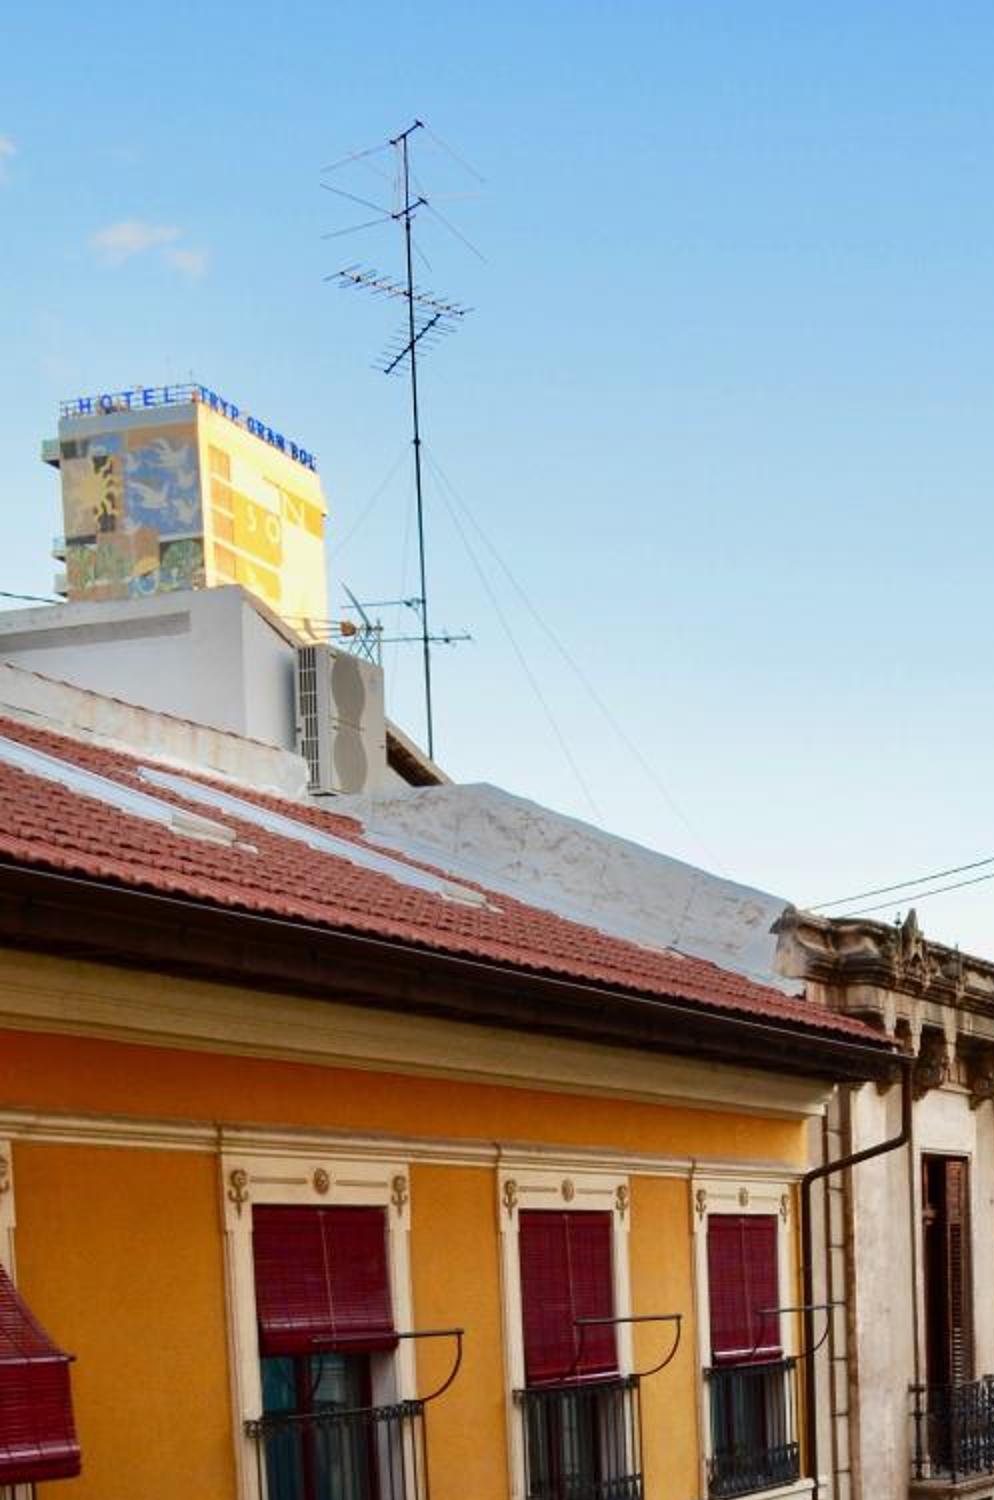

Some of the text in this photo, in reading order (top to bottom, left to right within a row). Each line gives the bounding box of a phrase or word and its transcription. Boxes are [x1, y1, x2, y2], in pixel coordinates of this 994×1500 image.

[77, 386, 175, 414] HOTEL
[200, 386, 239, 421] TRYP
[247, 415, 285, 452] GRAN
